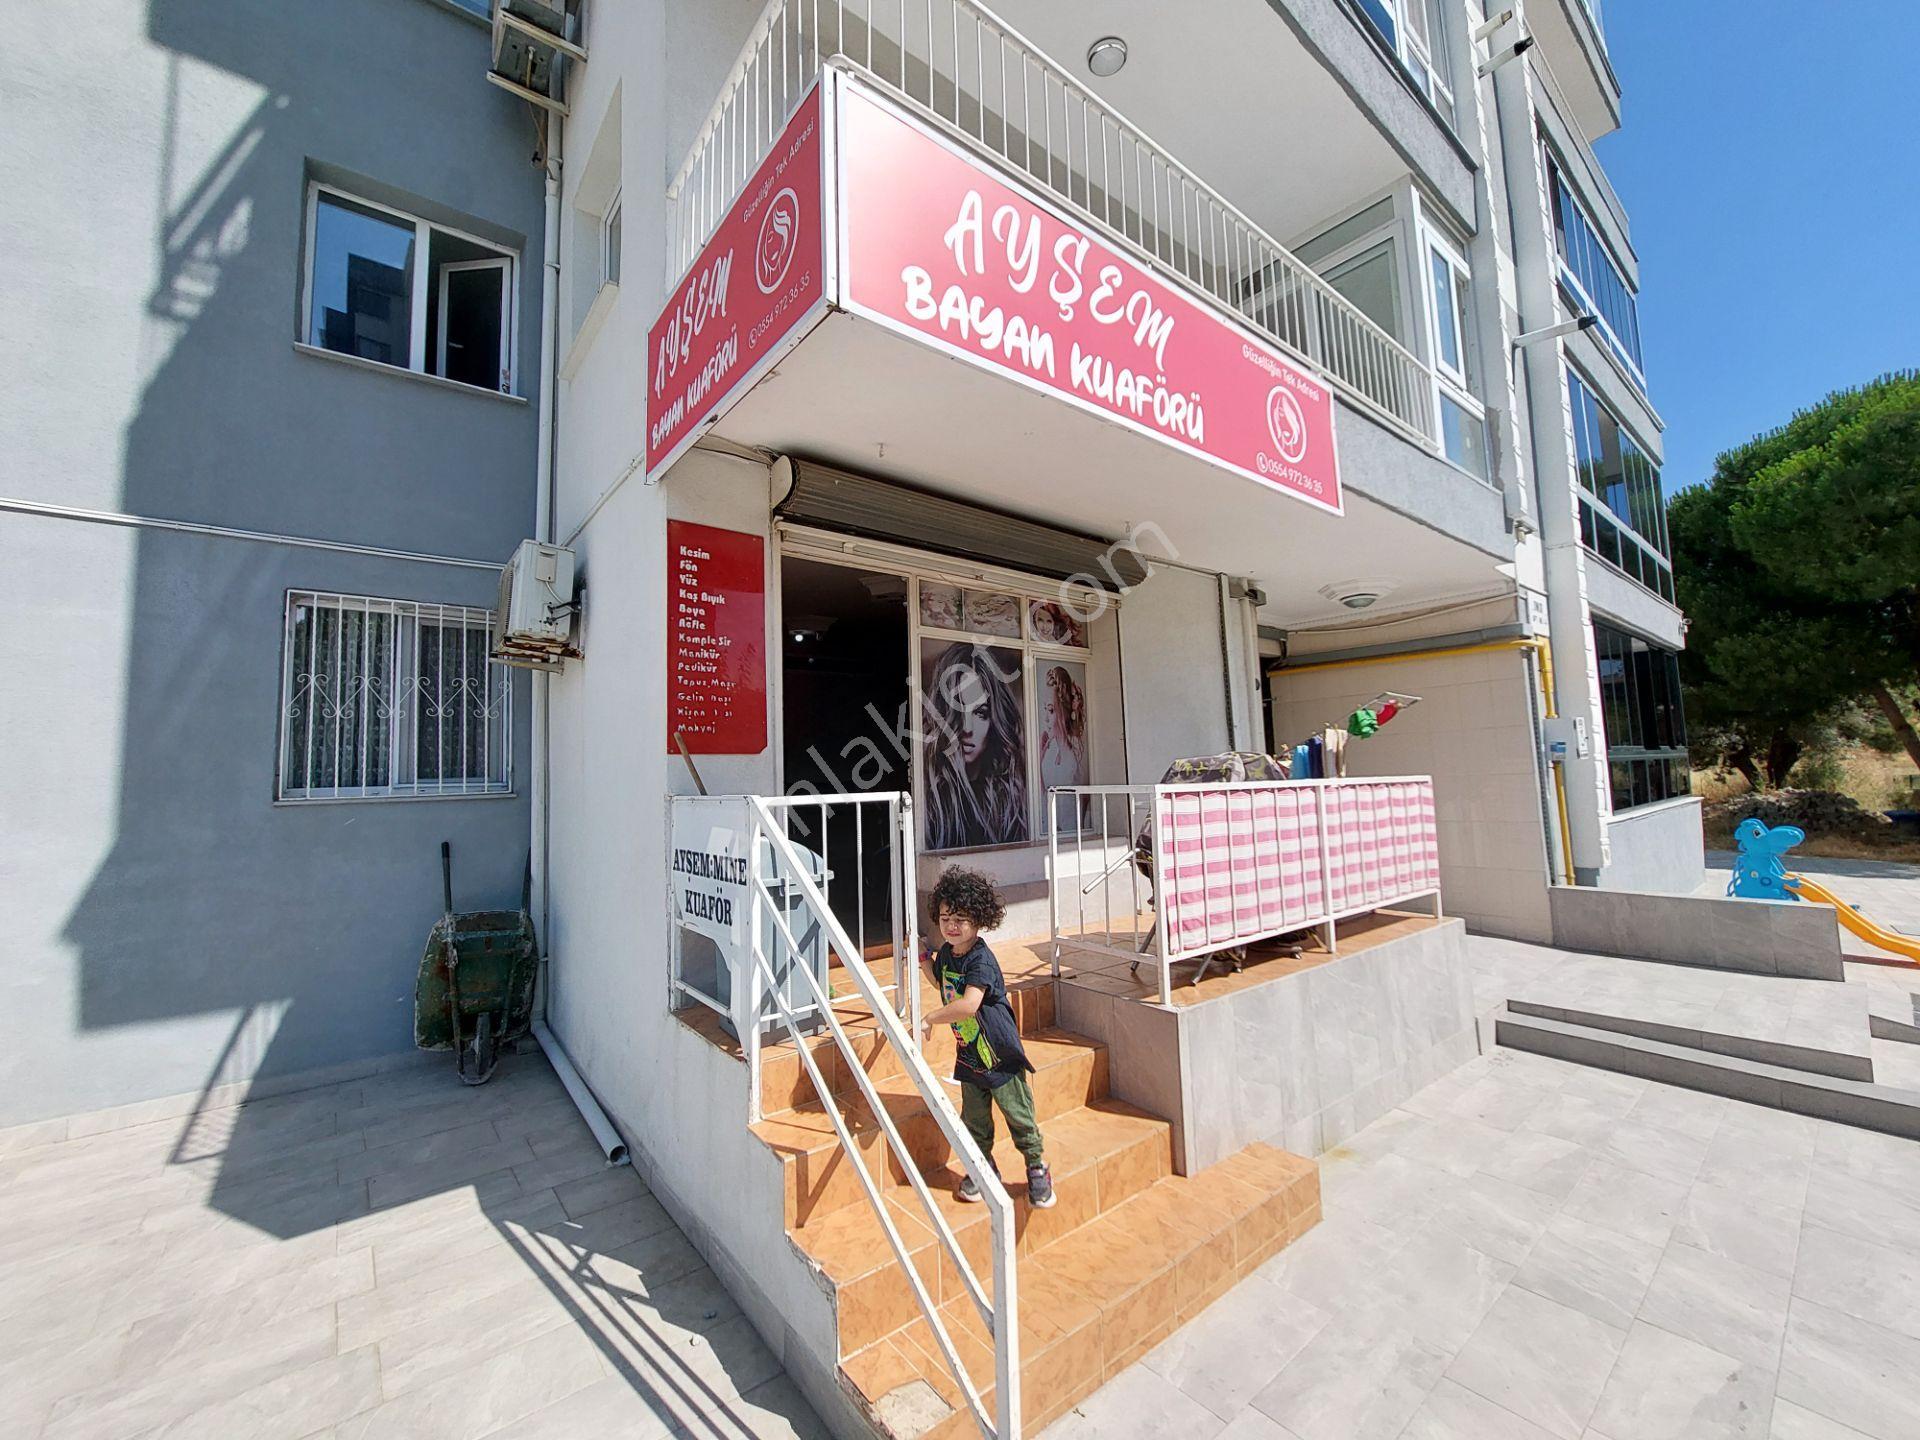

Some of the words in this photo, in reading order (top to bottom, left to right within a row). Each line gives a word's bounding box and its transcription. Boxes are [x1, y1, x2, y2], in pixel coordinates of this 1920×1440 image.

[944, 190, 1175, 370] AYŞEM
[757, 310, 774, 337] 0554
[774, 295, 788, 319] 972
[788, 283, 799, 303] 36
[655, 248, 733, 399] AYŞEM
[900, 265, 1056, 378] BAYAN
[1070, 342, 1205, 444] KUAFÖRÜ
[652, 396, 684, 450] BAYAN
[686, 323, 738, 414] KUAFÖRÜ
[1268, 459, 1288, 478] 0554
[1288, 468, 1303, 485] 972
[680, 545, 710, 560] Kesim
[679, 560, 698, 571] Fön
[679, 574, 698, 586] Yüz
[679, 589, 698, 602] Kaş
[701, 592, 725, 605] Bıyık
[679, 604, 706, 616] Boya
[678, 633, 716, 646] Komple
[678, 648, 720, 659] Manikür
[678, 662, 718, 673] Pedikür
[677, 691, 704, 702] Gelin
[685, 887, 732, 927] KUAFÖR
